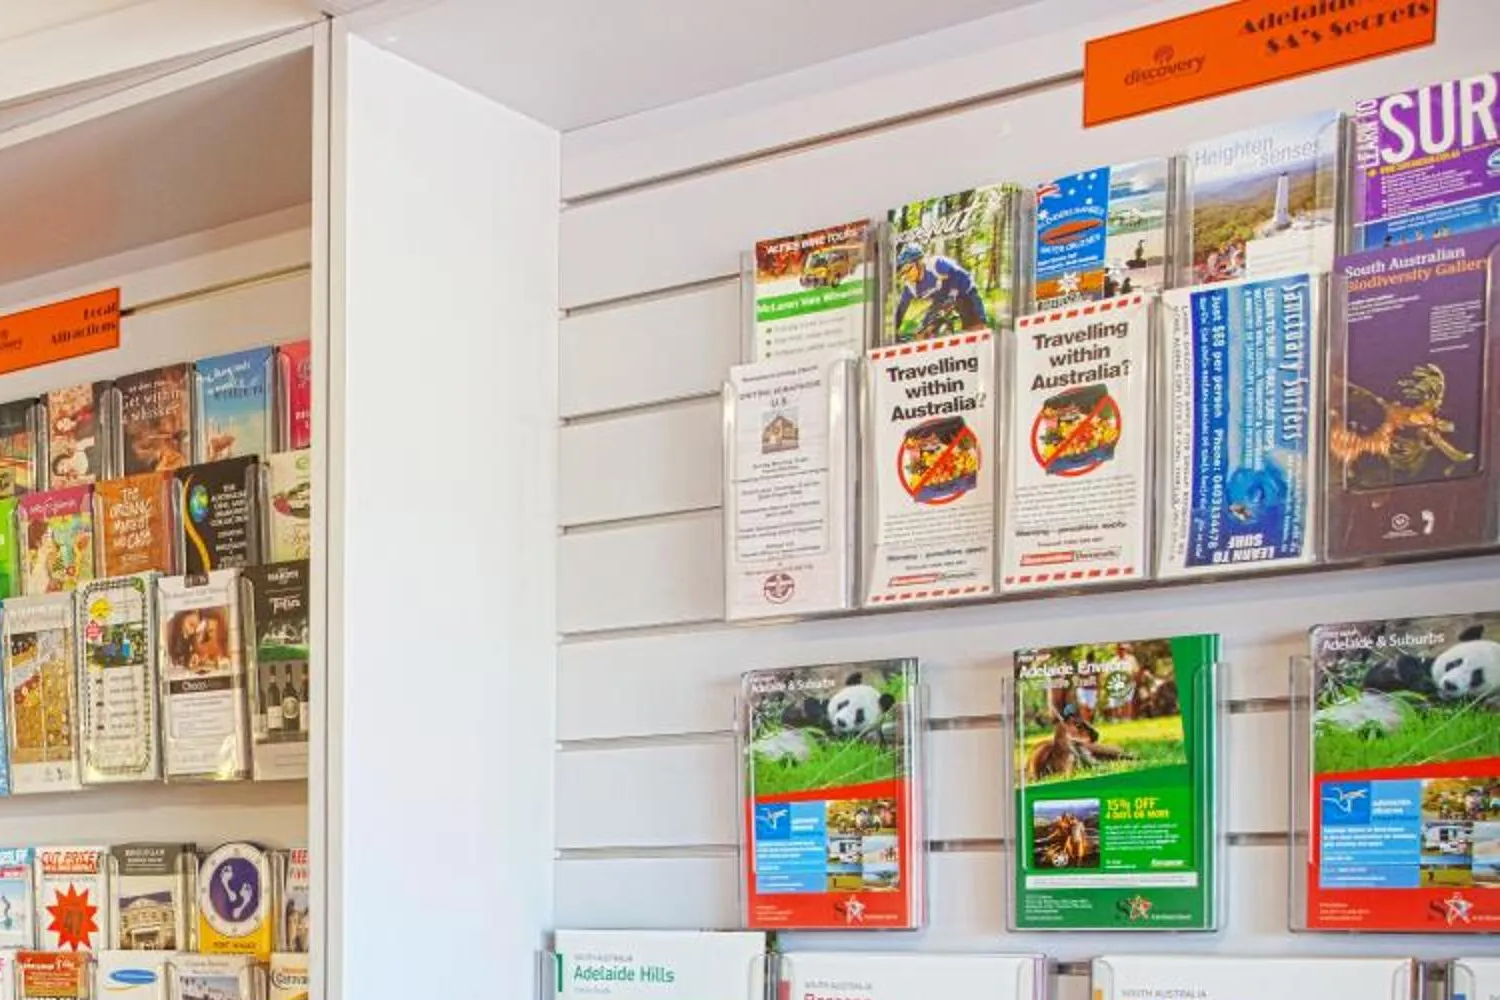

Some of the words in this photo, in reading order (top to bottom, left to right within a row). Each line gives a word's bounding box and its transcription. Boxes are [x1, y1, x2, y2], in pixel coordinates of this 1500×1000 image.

[1329, 2, 1432, 40] Secrets
[1124, 53, 1206, 87] discovery
[1194, 136, 1274, 168] Heighten
[1345, 259, 1386, 279] South
[1389, 246, 1466, 271] Australian
[1033, 323, 1129, 352] Travelling
[1280, 283, 1308, 372] Sanctuary
[886, 355, 979, 384] Travelling
[1049, 347, 1111, 369] within
[905, 378, 965, 401] within
[1031, 362, 1133, 392] Australia?
[891, 393, 987, 422] Australia?
[1281, 378, 1308, 442] Surfers
[1376, 634, 1386, 648] &
[1389, 632, 1445, 648] Suburbs
[573, 964, 635, 985] Adelaide
[639, 965, 676, 985] Hills
